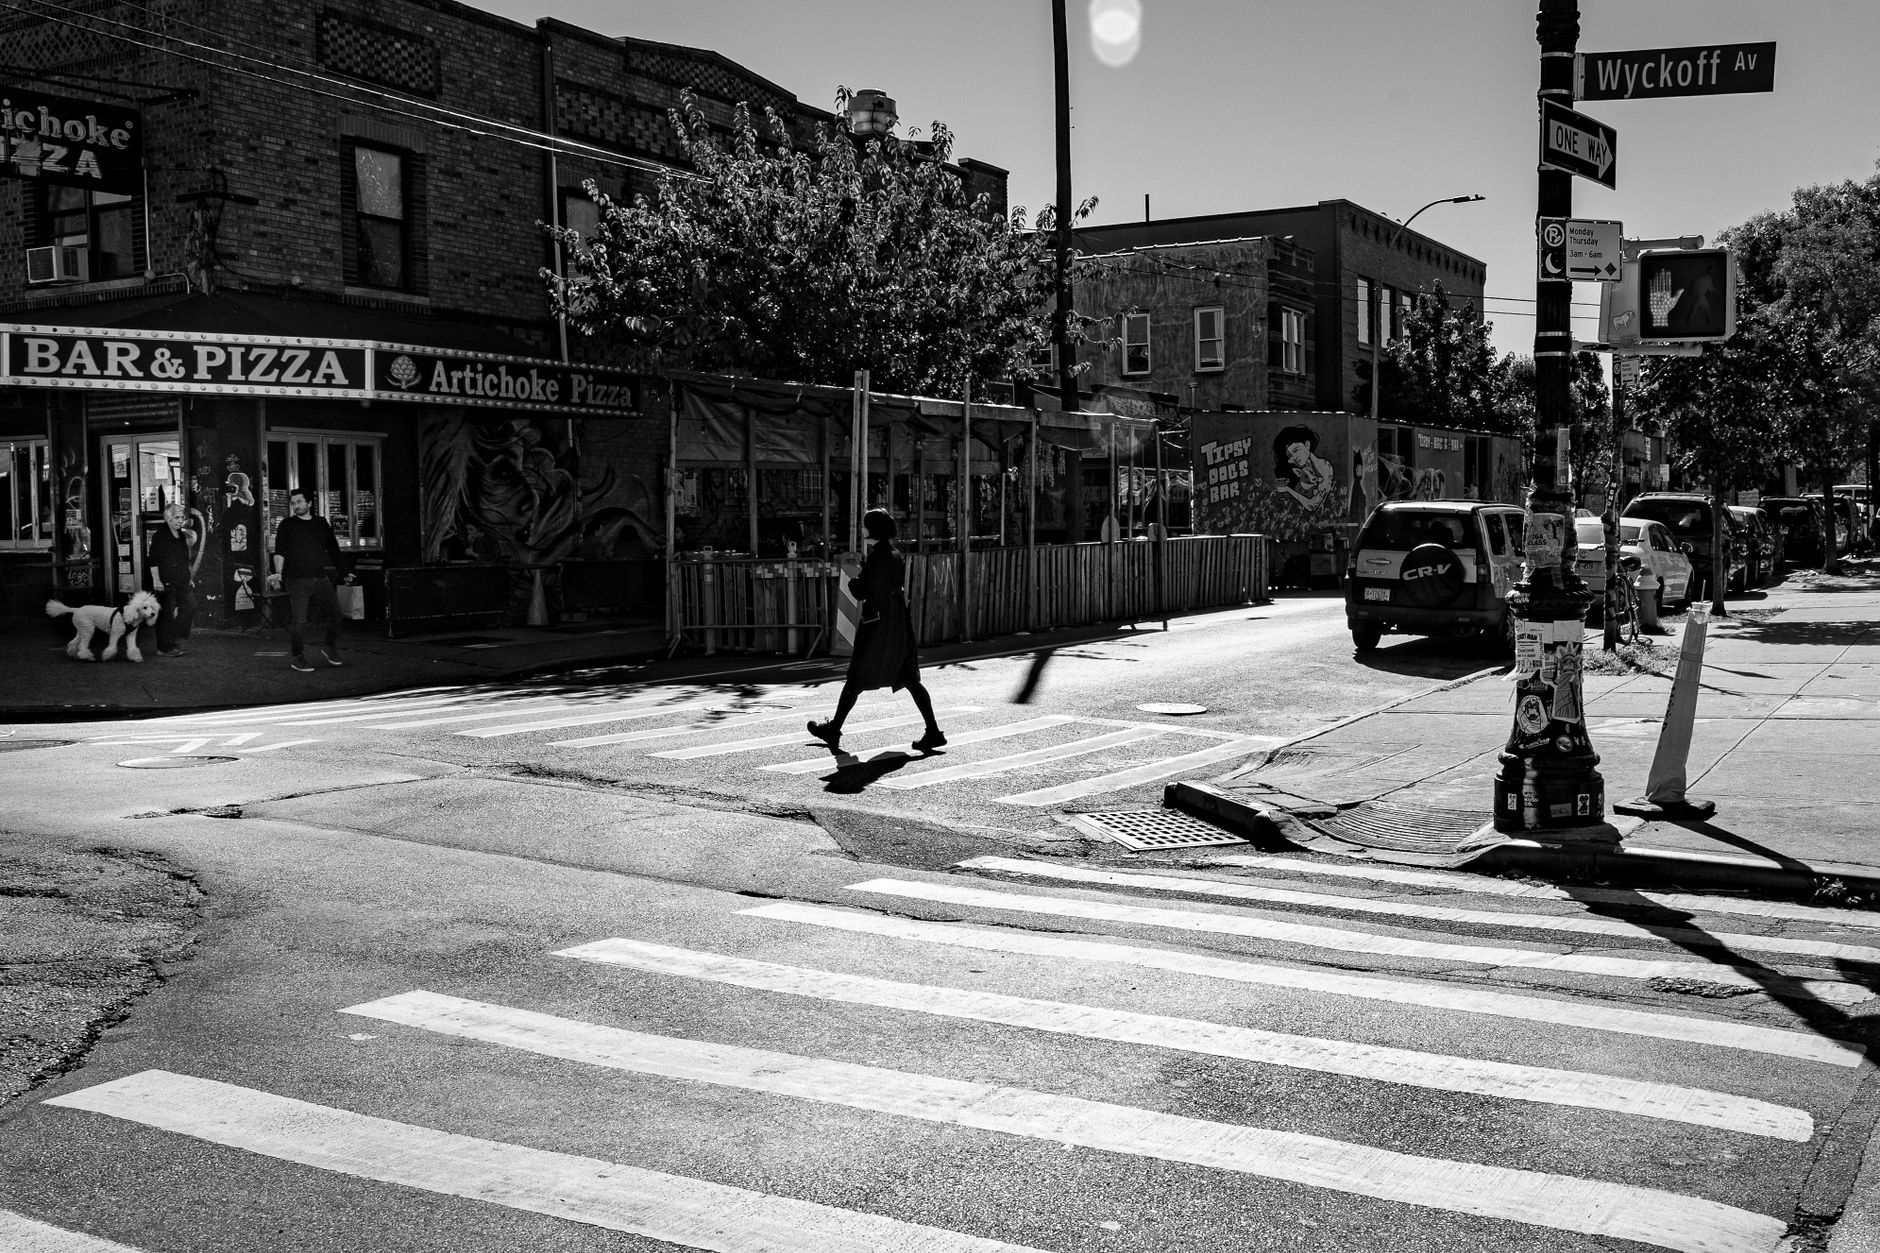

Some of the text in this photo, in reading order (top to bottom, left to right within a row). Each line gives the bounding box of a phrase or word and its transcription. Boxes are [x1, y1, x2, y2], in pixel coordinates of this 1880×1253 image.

[1597, 50, 1757, 98] Wyckoff Av
[1556, 126, 1607, 166] ONE WAY
[1569, 227, 1594, 237] Monday
[1569, 236, 1599, 246] Thursday
[1569, 250, 1583, 258] 3am
[23, 337, 349, 385] BAR & PIZZA
[429, 360, 633, 408] Artichoke Pizza
[1200, 436, 1252, 466] TIPSY
[1208, 460, 1249, 485] DOG'S
[1210, 481, 1240, 504] BAR
[1402, 563, 1452, 581] CR-V
